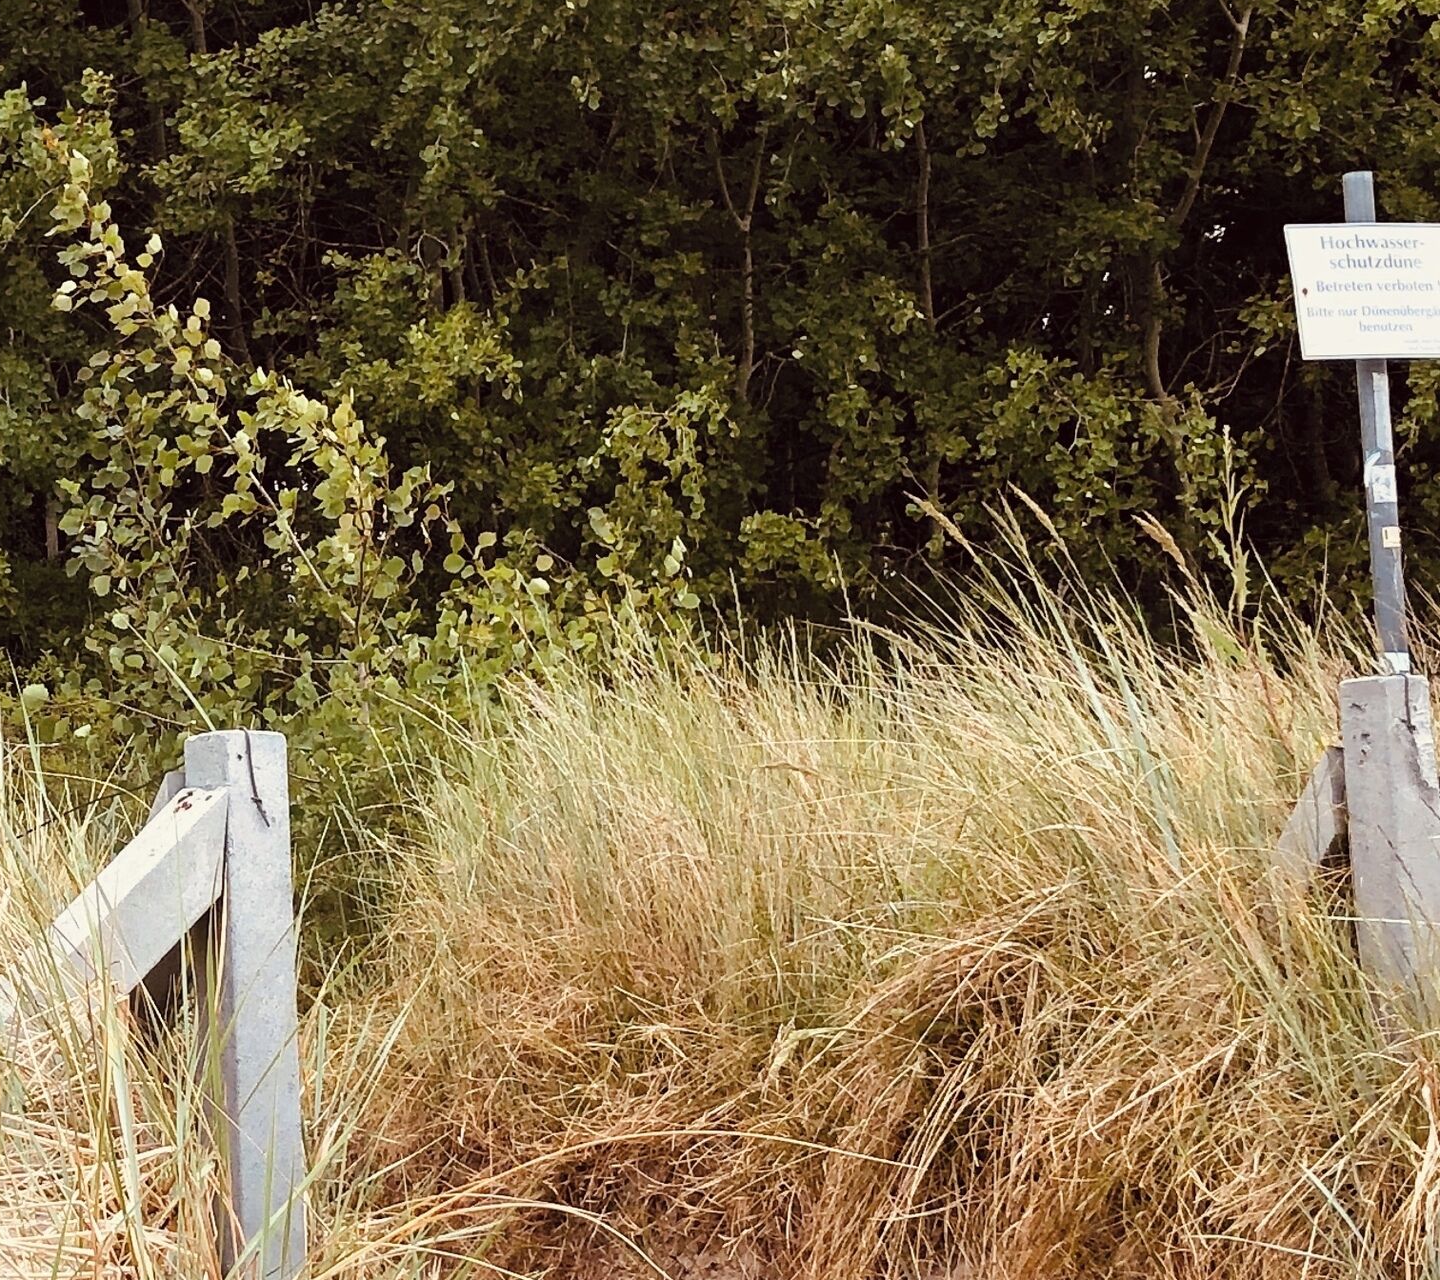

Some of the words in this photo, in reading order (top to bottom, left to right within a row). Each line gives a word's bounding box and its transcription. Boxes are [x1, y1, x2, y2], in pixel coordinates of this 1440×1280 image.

[1320, 234, 1425, 250] Hochwasser-
[1316, 281, 1372, 293] Betreten
[1377, 279, 1433, 292] verboten
[1307, 307, 1334, 318] Bitte
[1338, 308, 1357, 317] nur
[1359, 322, 1413, 333] benutzen
